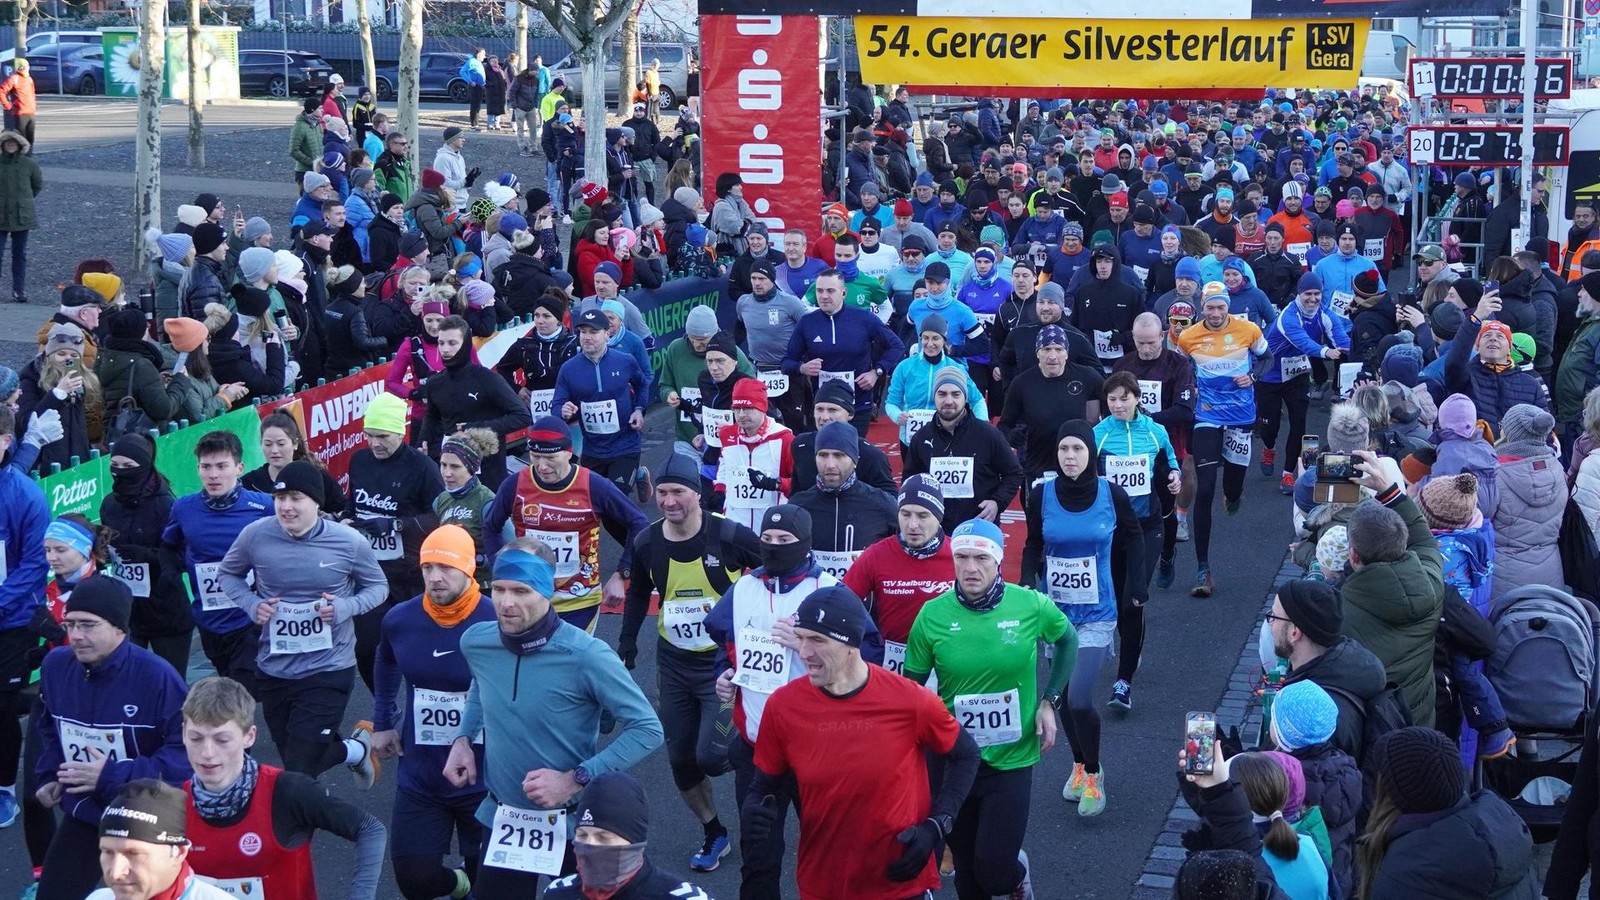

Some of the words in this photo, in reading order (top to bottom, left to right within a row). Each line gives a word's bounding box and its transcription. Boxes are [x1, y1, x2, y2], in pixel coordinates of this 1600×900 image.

[1311, 26, 1350, 46] 1.SV
[867, 25, 919, 58] 54.
[926, 27, 1047, 59] Geraer
[1063, 26, 1296, 71] Silvesterlauf
[1311, 49, 1350, 67] Gera
[1416, 70, 1434, 85] 11
[1413, 138, 1432, 152] 20
[1141, 392, 1157, 405] 53
[584, 411, 613, 424] 2117
[1226, 435, 1249, 456] 2059
[934, 470, 968, 485] 2267
[1112, 472, 1145, 488] 1208
[52, 478, 97, 511] Petters
[355, 488, 398, 511] Debeka
[734, 484, 765, 499] 1327
[552, 547, 573, 563] 17
[113, 561, 144, 581] 2239
[1056, 560, 1064, 568] SV
[1065, 561, 1080, 569] Gera
[203, 578, 224, 594] 22
[897, 579, 931, 589] Saalburg
[1051, 571, 1091, 589] 2256
[283, 606, 292, 614] SV
[293, 607, 310, 615] Gera
[675, 605, 684, 614] SV
[685, 604, 701, 614] Gera
[276, 616, 323, 637] 2080
[672, 621, 702, 640] 137
[760, 636, 776, 645] Gera
[742, 648, 784, 675] 2236
[429, 694, 439, 702] SV
[440, 695, 460, 703] Gera
[981, 698, 1000, 706] Gera
[421, 707, 461, 728] 209
[962, 708, 1011, 729] 2101
[84, 731, 102, 741] Gera
[106, 806, 158, 824] swisscom
[509, 810, 520, 819] SV
[522, 813, 543, 823] Gera
[498, 823, 554, 852] 2181
